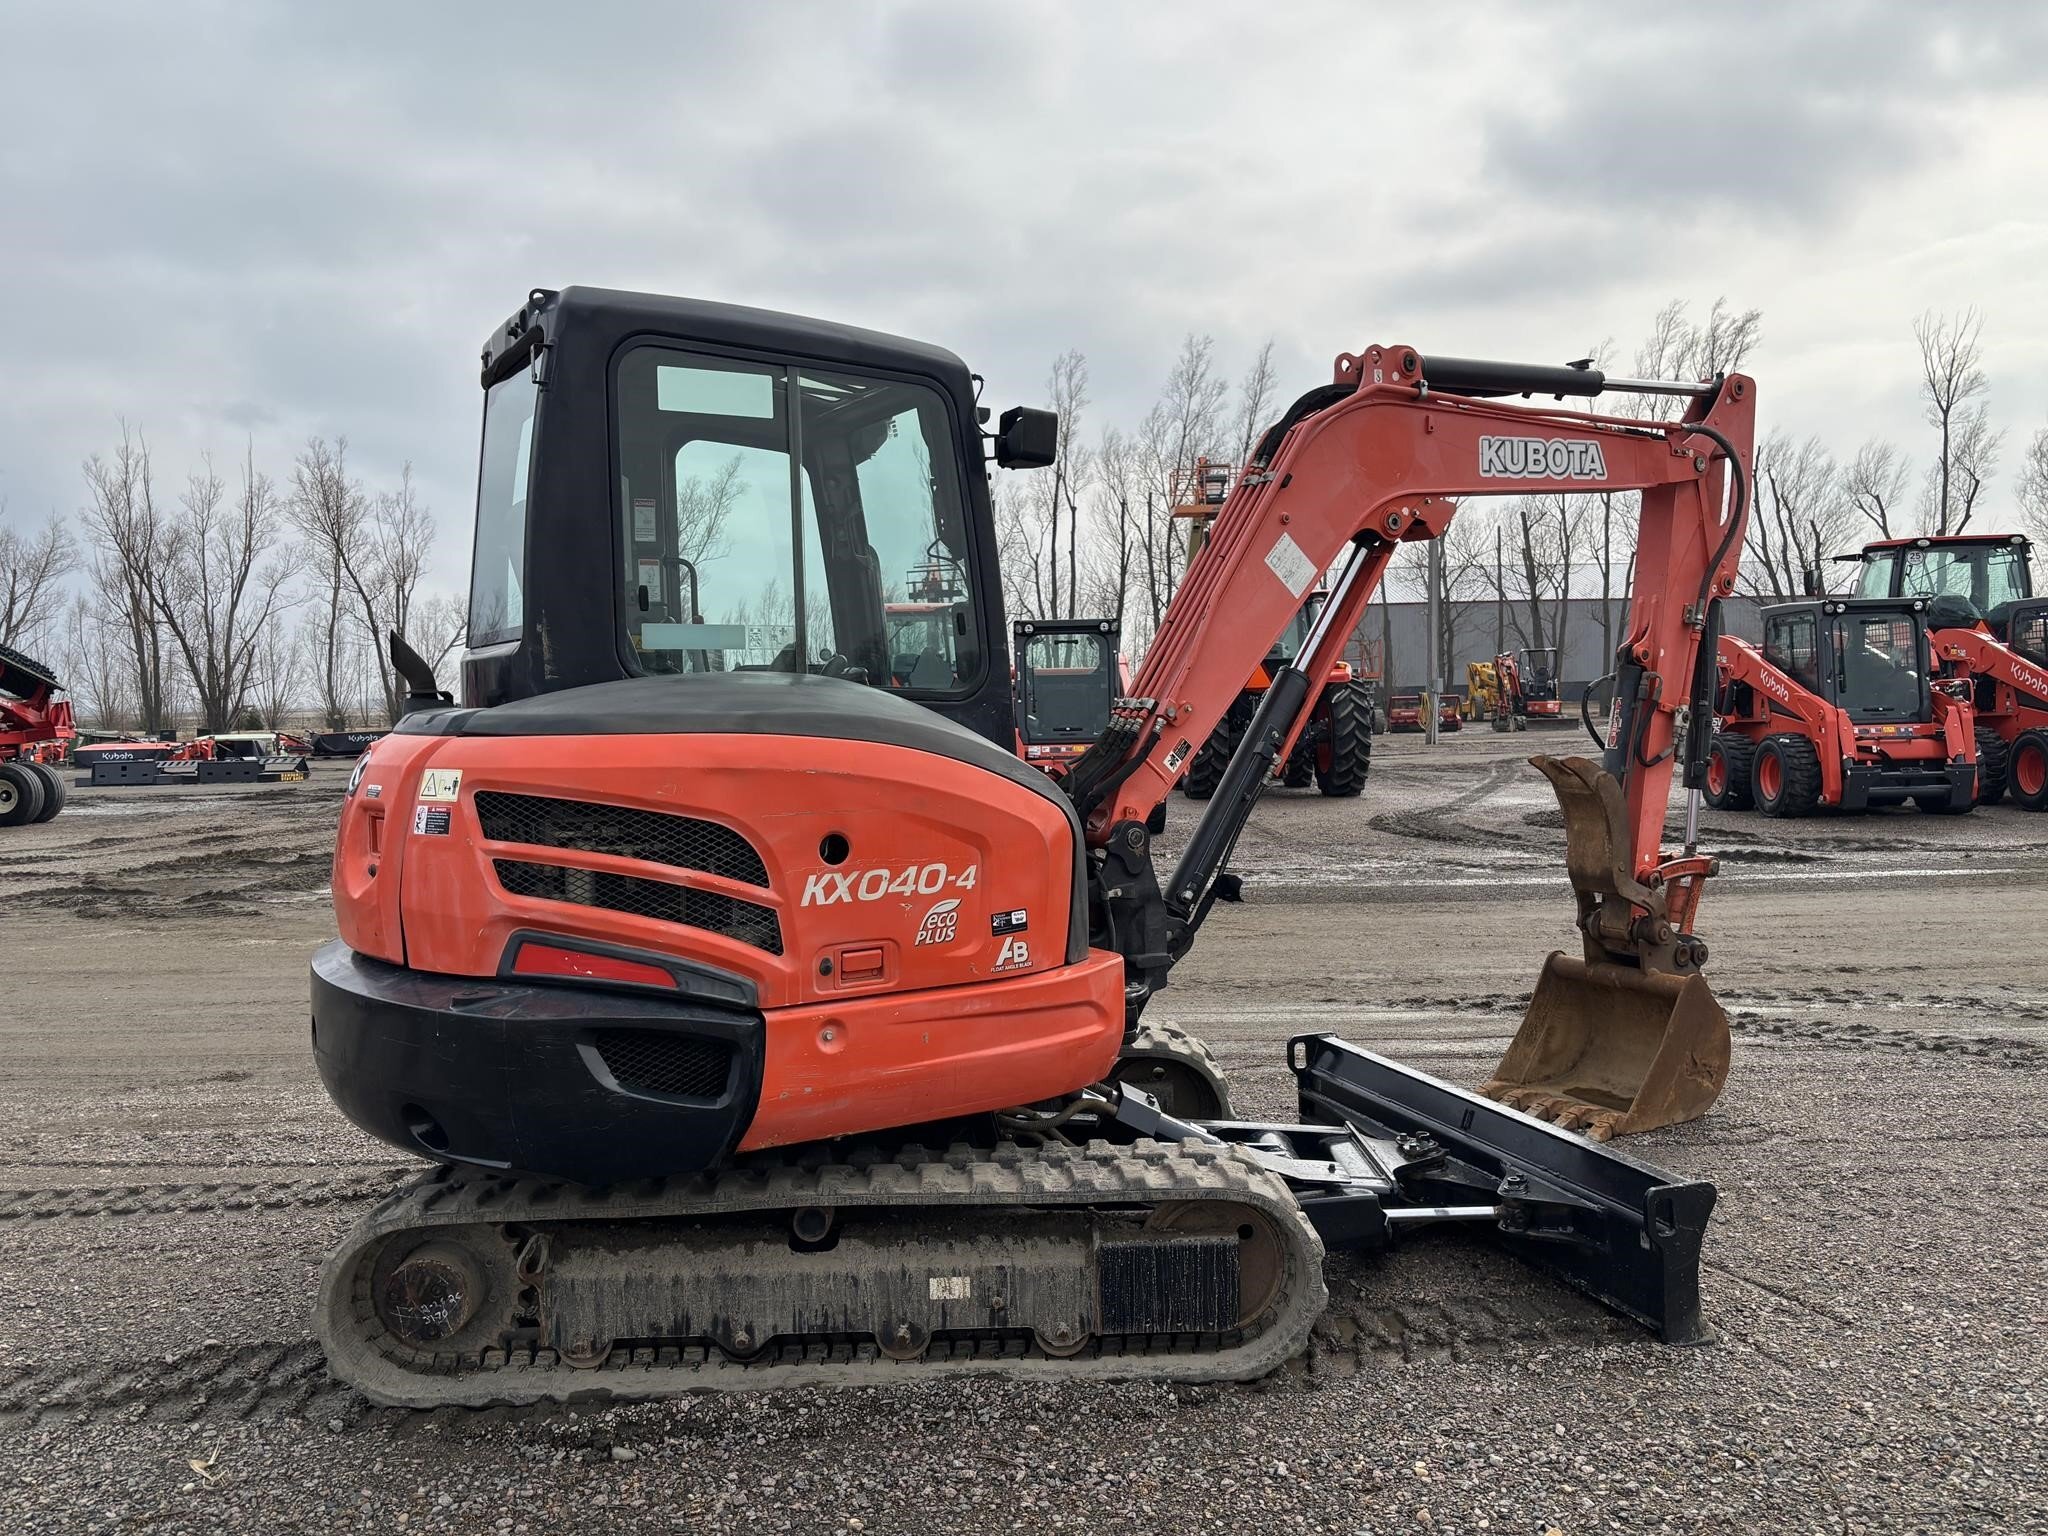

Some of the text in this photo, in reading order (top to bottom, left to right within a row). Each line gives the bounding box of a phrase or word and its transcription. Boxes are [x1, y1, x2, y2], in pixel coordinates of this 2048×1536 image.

[1480, 437, 1606, 479] KUBOTA
[1910, 552, 1921, 560] 25
[1760, 668, 1790, 702] Kubota
[102, 752, 133, 760] Kubota
[800, 863, 977, 907] KX040-4
[926, 911, 957, 929] eco
[914, 925, 956, 946] PLUS
